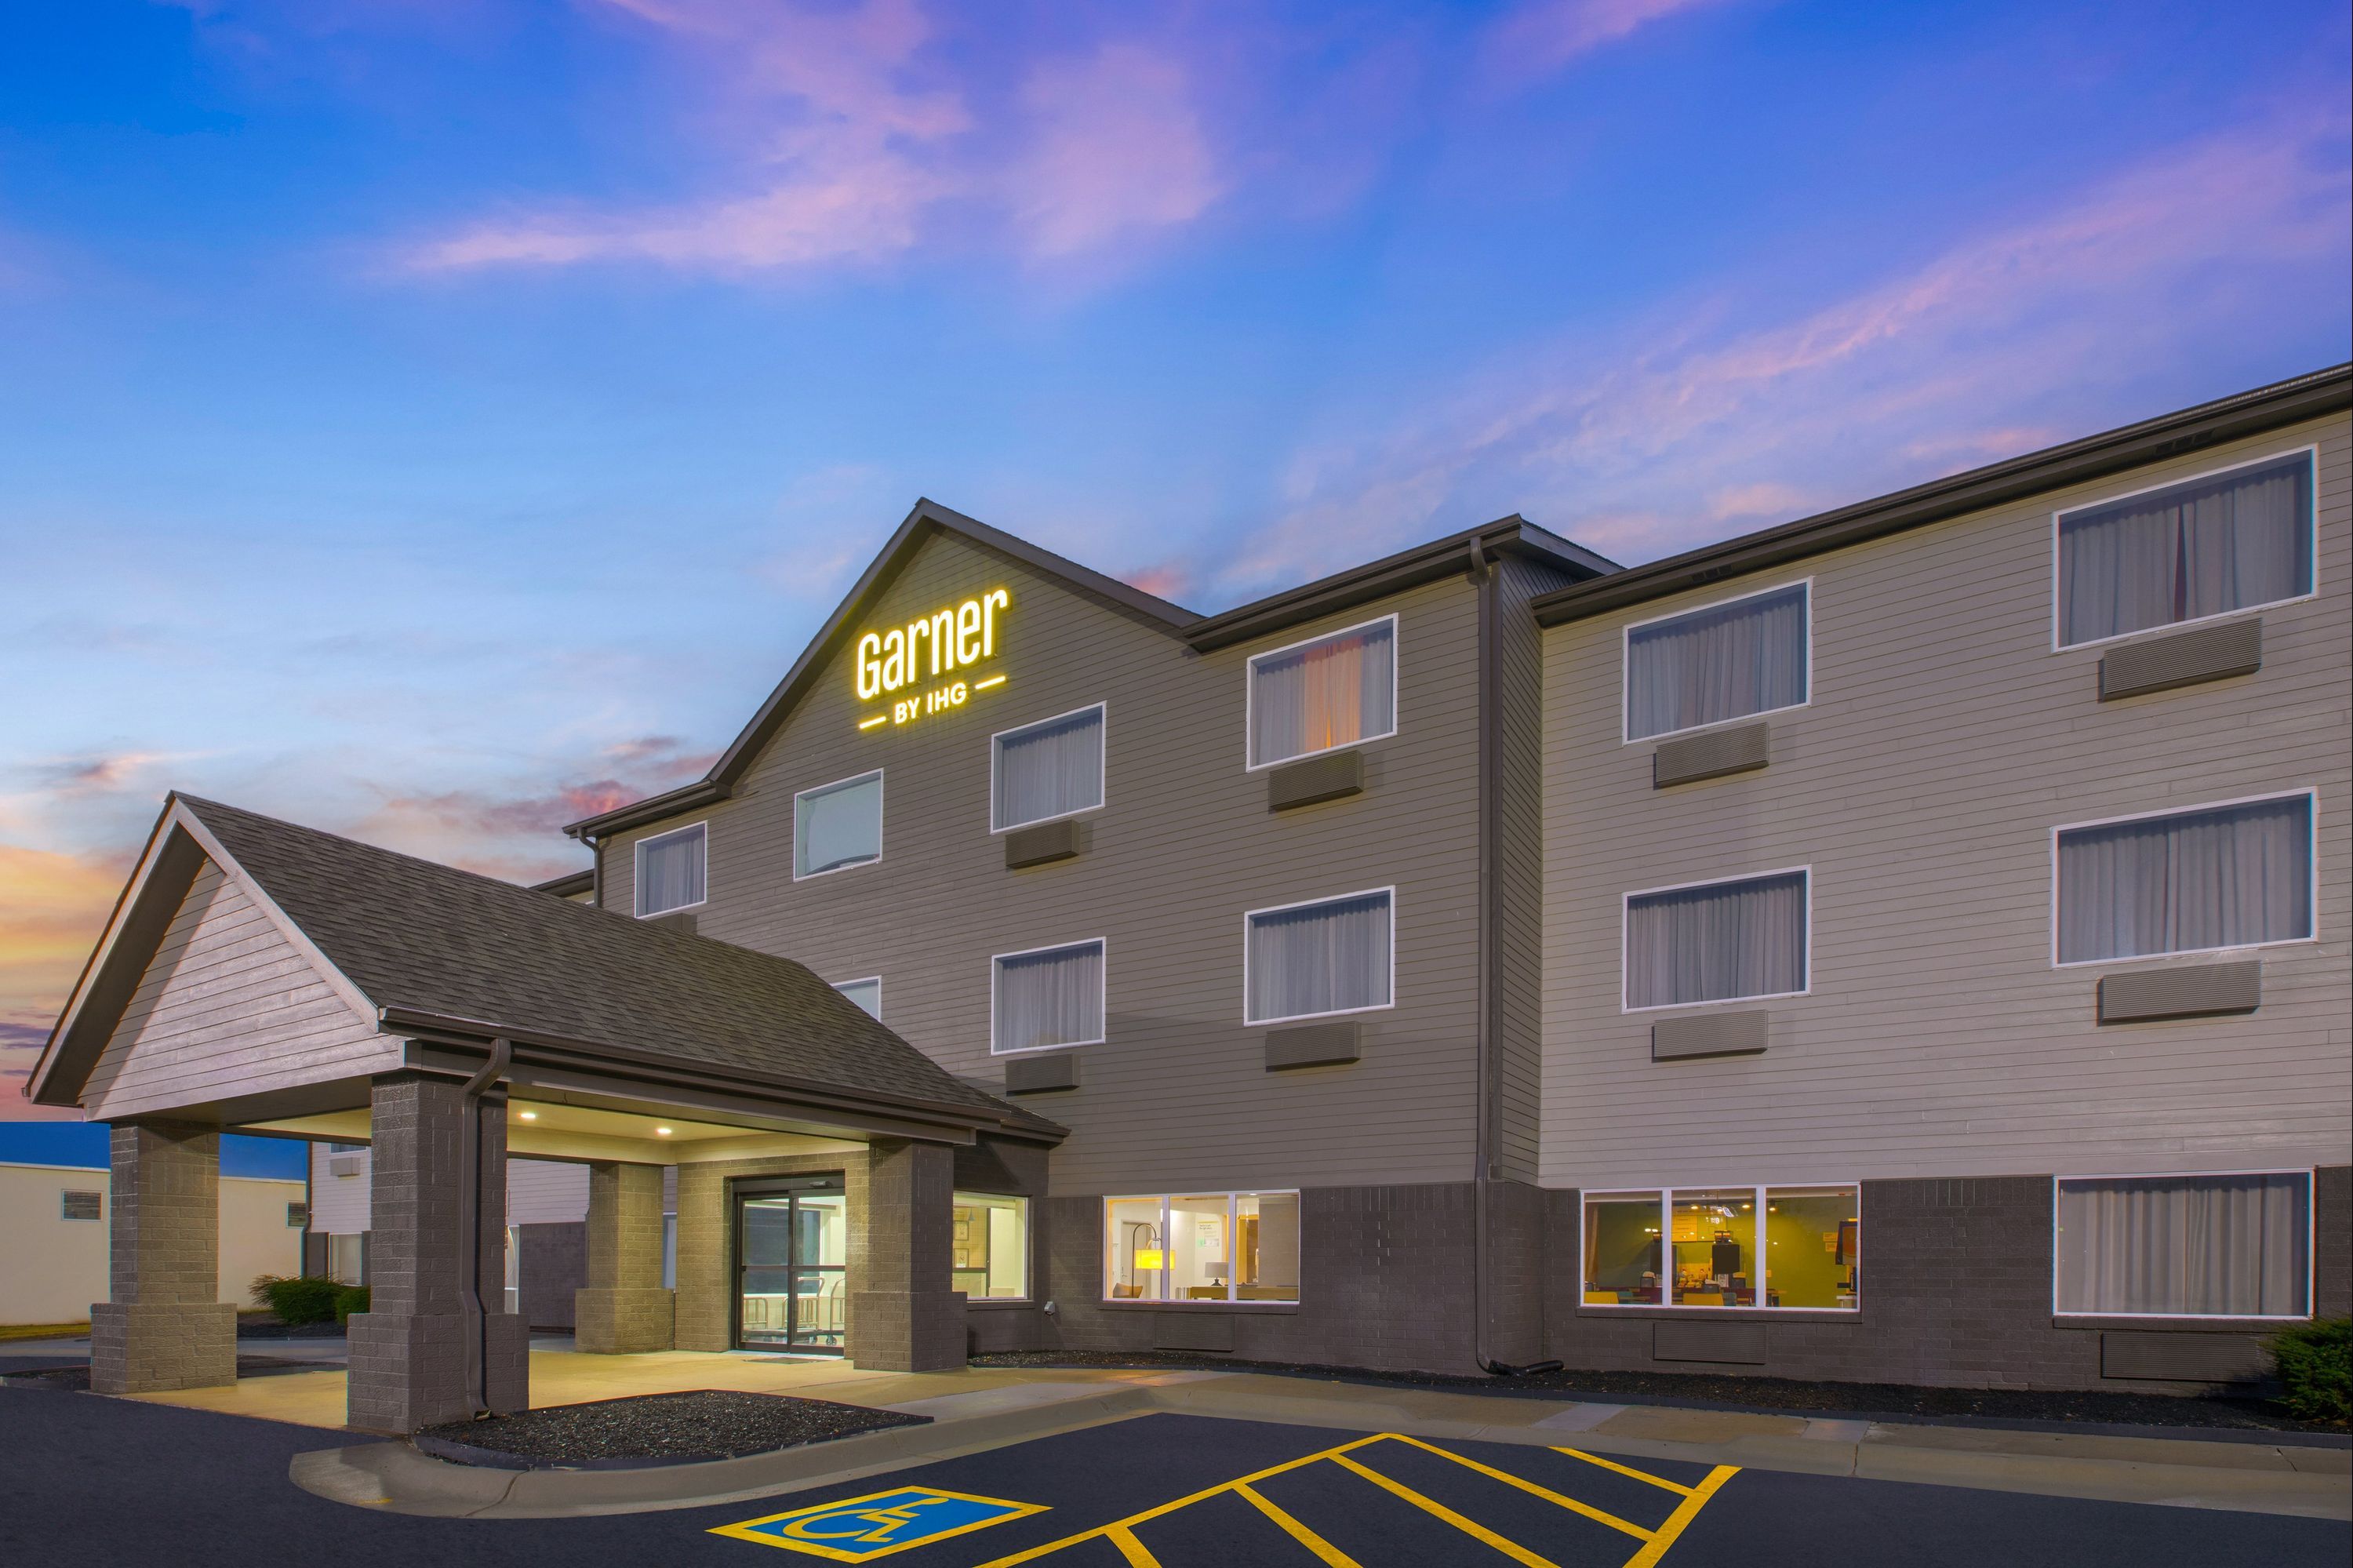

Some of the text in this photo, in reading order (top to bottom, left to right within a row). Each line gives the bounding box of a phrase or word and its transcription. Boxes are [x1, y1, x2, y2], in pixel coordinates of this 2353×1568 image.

[857, 589, 1008, 700] Garner
[895, 682, 967, 724] BY IHG
